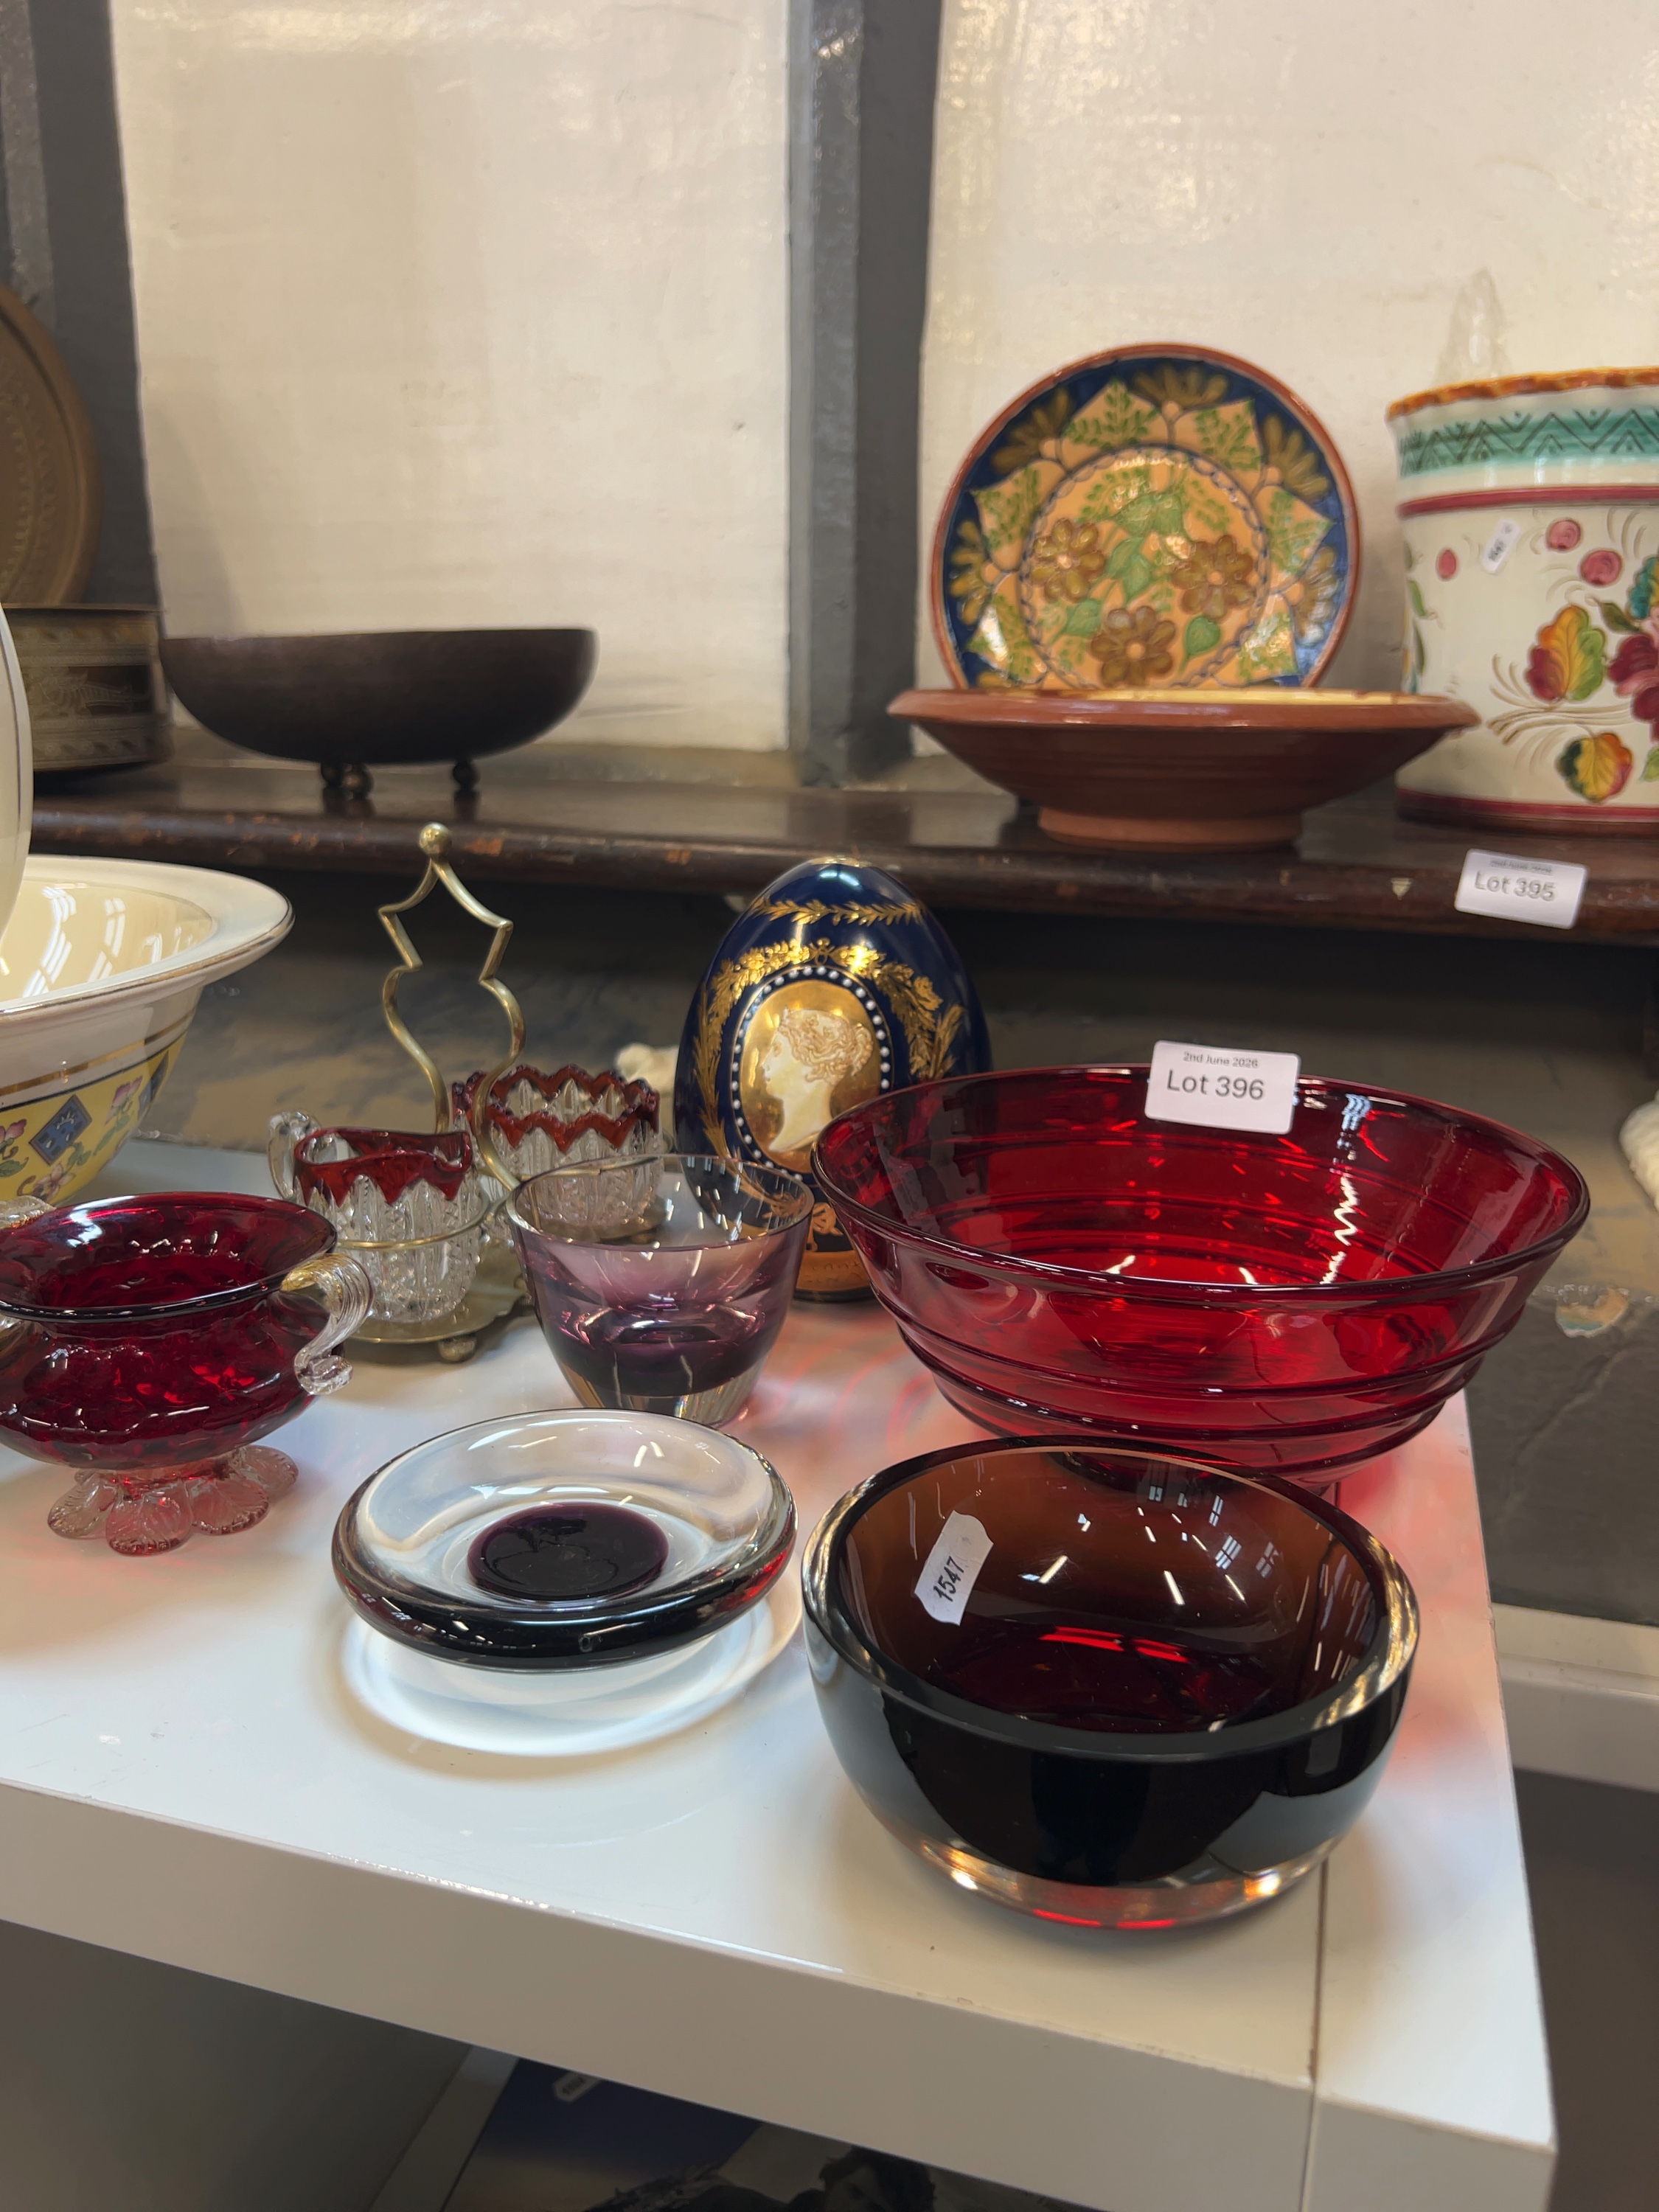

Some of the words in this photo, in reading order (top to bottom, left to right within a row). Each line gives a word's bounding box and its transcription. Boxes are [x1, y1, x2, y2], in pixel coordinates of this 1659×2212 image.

[1474, 869, 1509, 894] Lot
[1514, 877, 1556, 902] 395
[1183, 1051, 1203, 1063] 2nd
[1206, 1054, 1230, 1066] June
[1166, 1068, 1208, 1094] Lot
[1215, 1076, 1265, 1101] 396
[933, 1555, 964, 1602] 1547
